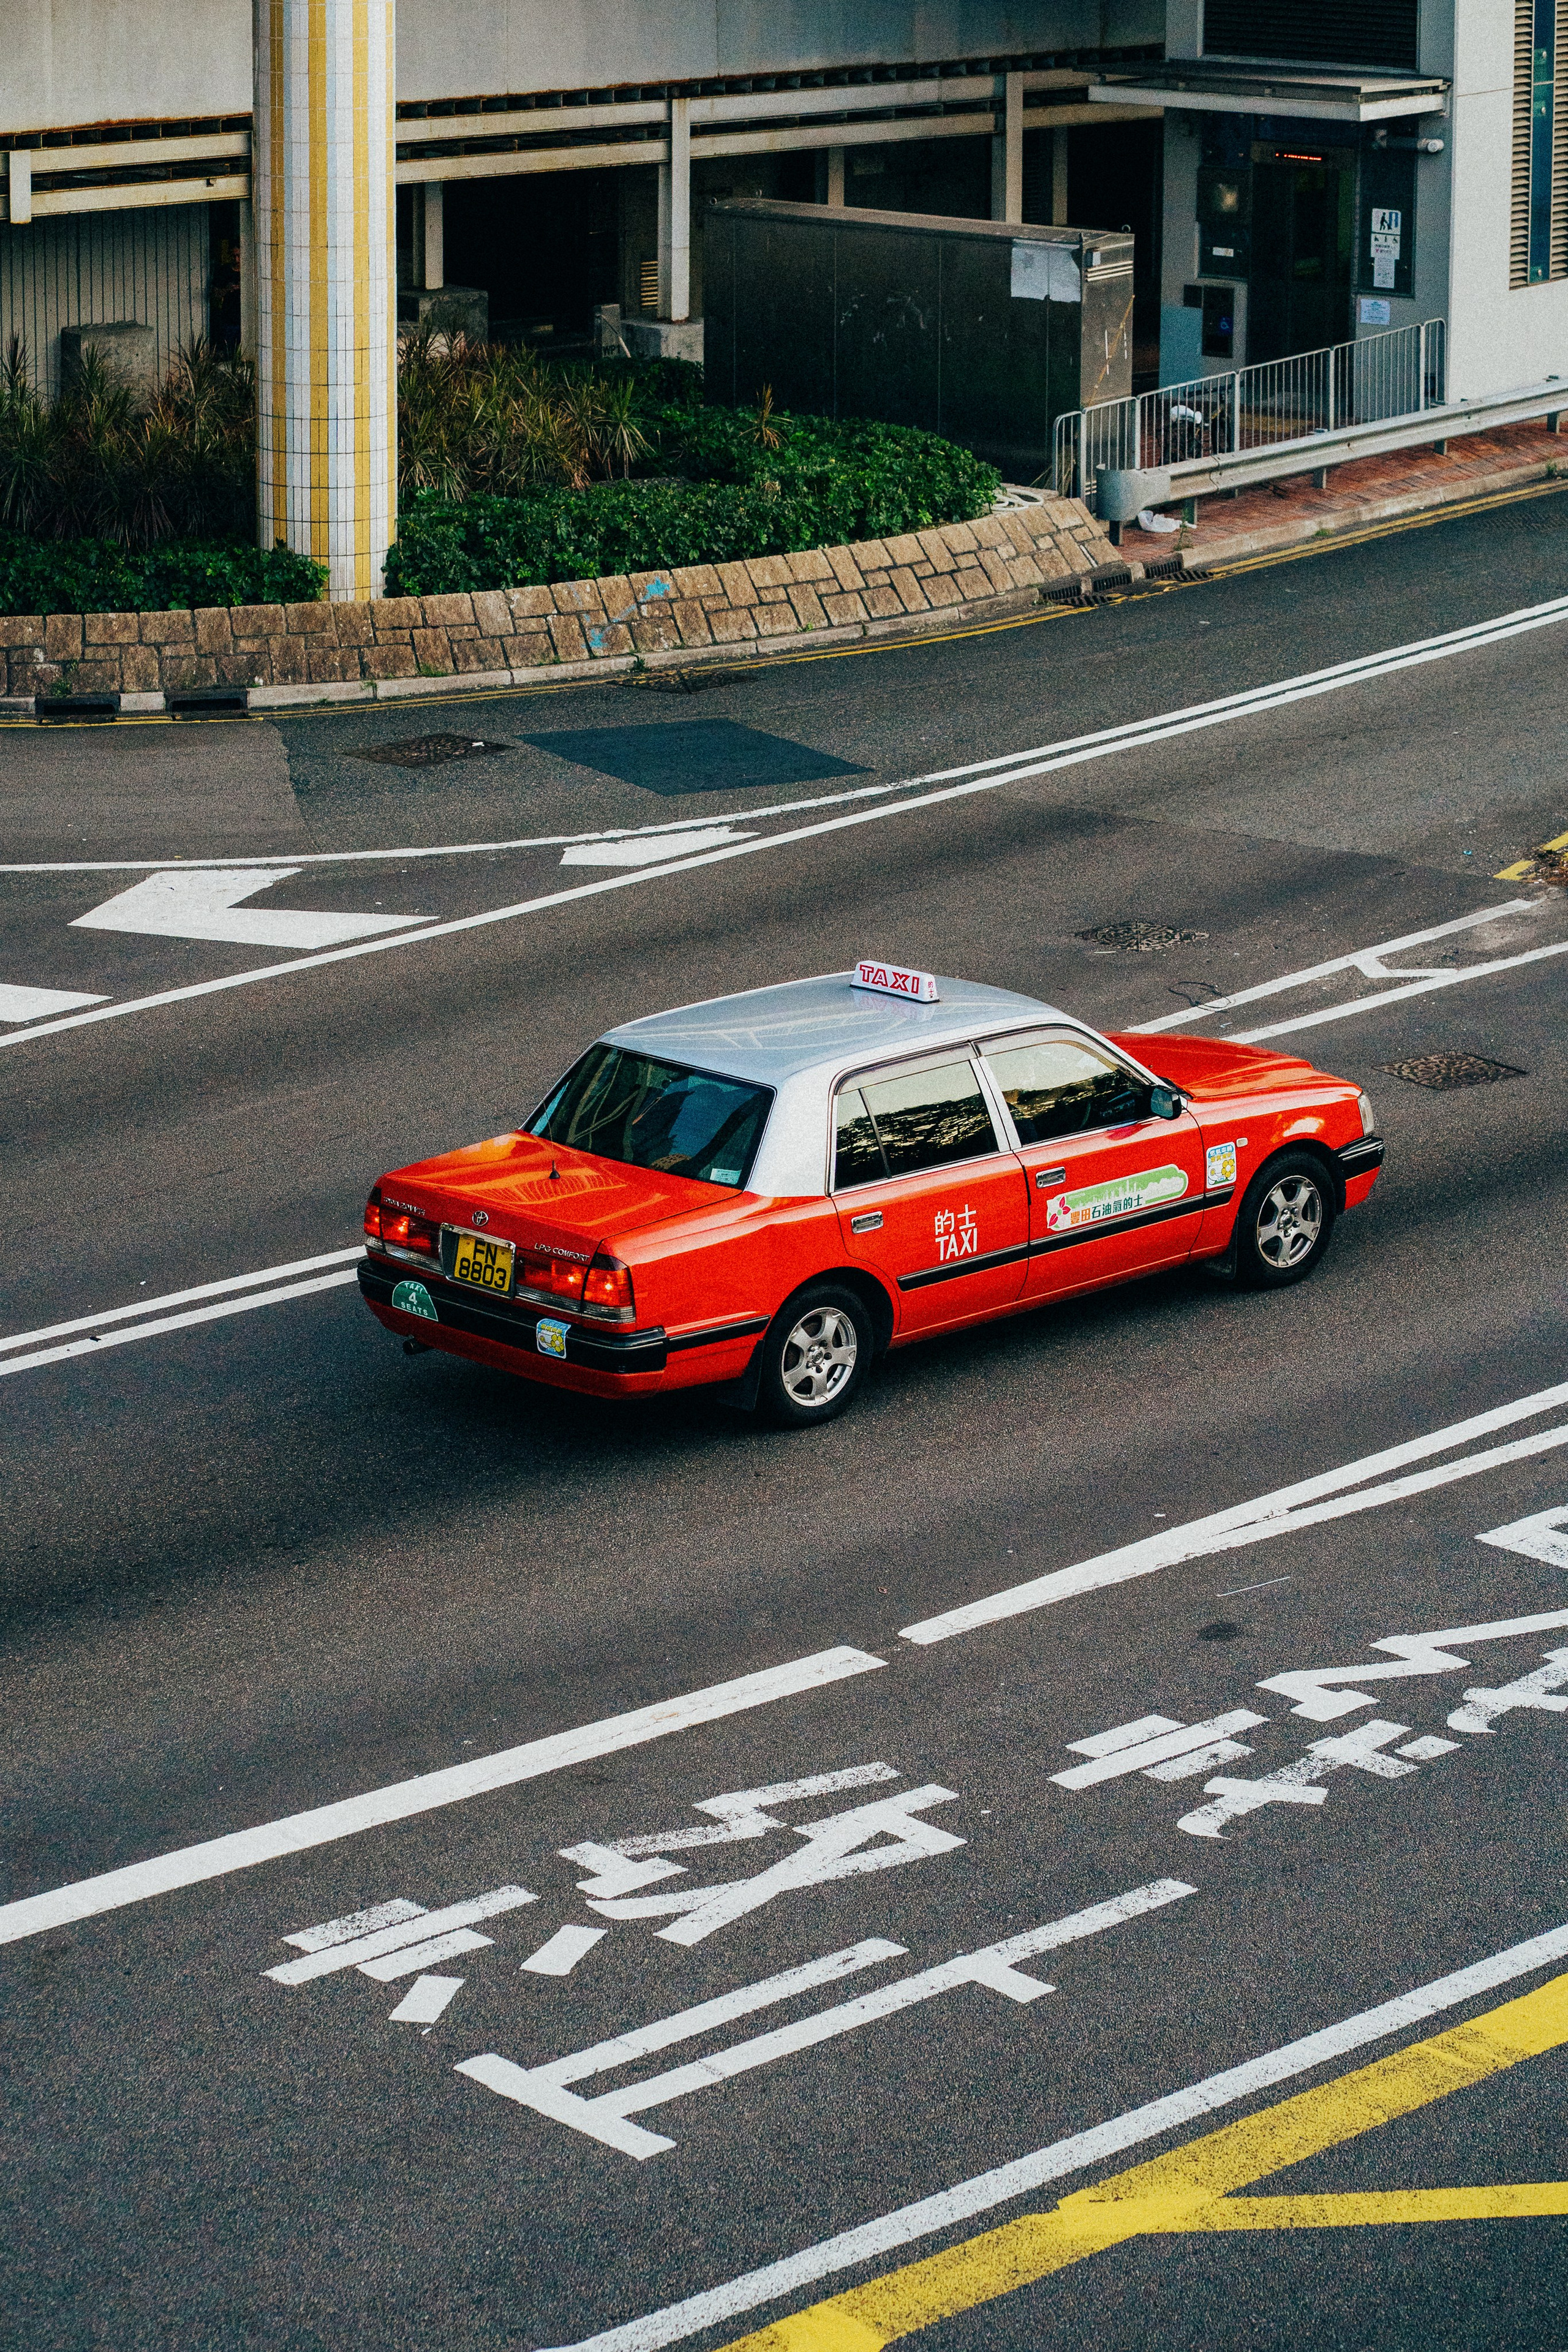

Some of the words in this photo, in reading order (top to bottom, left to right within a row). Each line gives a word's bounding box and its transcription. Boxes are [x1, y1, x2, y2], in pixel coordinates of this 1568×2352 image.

[859, 963, 920, 995] TAXI
[934, 1204, 977, 1236] 的士
[473, 1239, 498, 1266] FN
[534, 1242, 551, 1253] LPG
[552, 1247, 590, 1262] COMFORT
[935, 1227, 978, 1261] TAXI
[458, 1257, 507, 1289] 8803
[404, 1282, 423, 1294] TAXI
[408, 1292, 418, 1305] 4
[401, 1302, 428, 1316] SEATS
